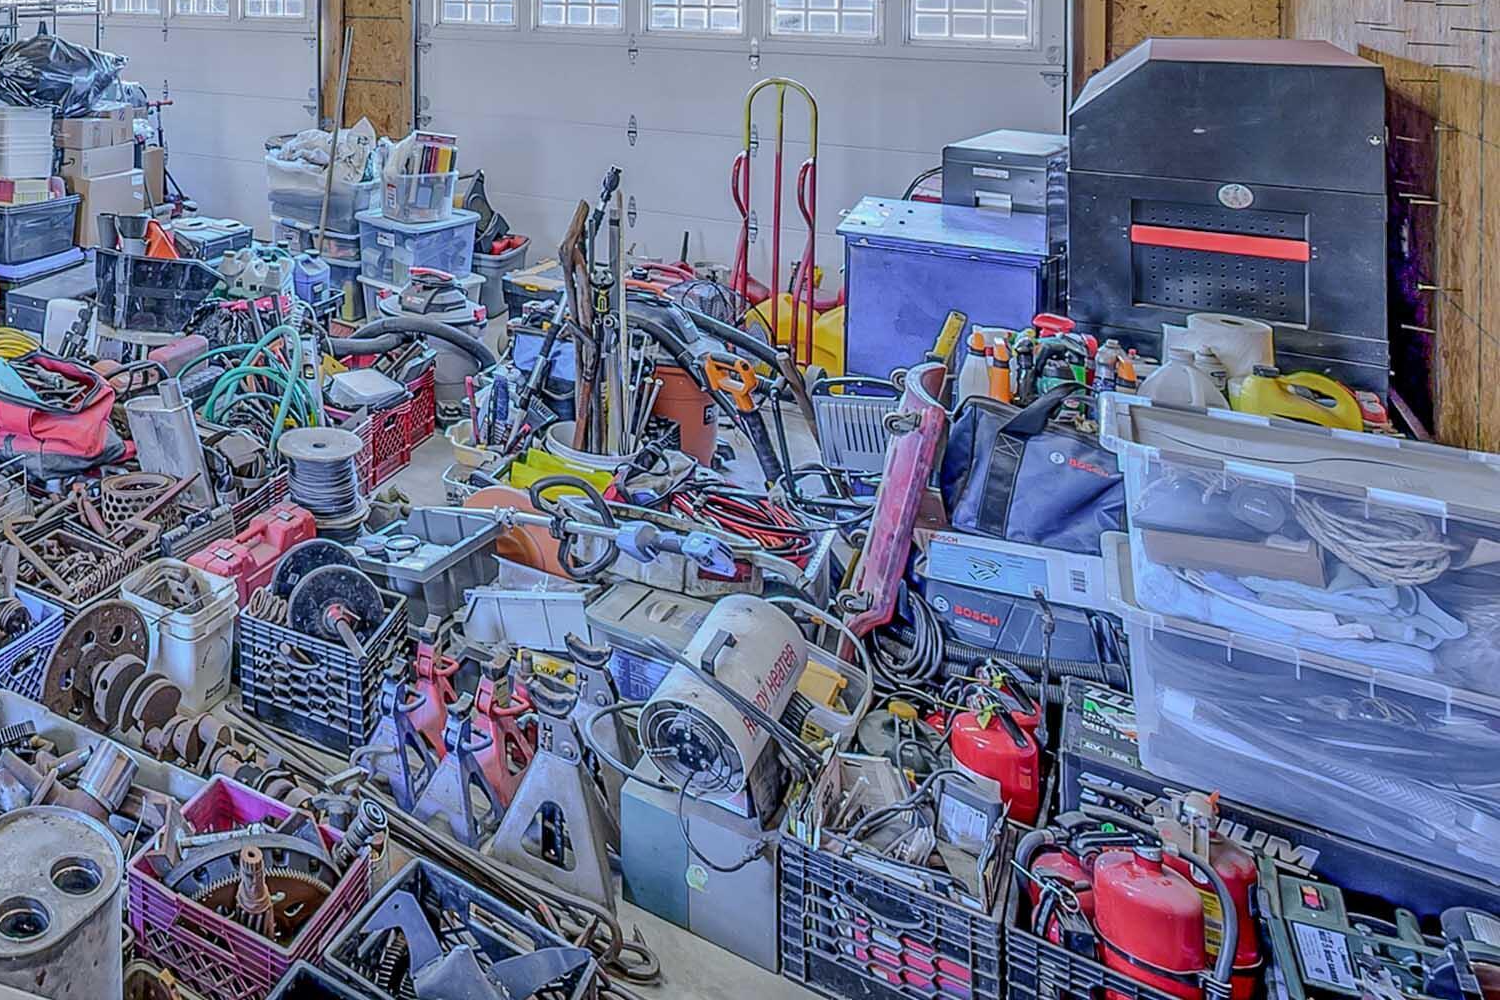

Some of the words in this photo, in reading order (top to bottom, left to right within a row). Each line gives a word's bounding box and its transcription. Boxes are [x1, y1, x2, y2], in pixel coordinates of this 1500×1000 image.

[1068, 457, 1109, 477] BOSCH
[929, 533, 958, 544] BOSCH
[953, 604, 999, 627] BOSCH
[1079, 772, 1321, 870] TTAIUM
